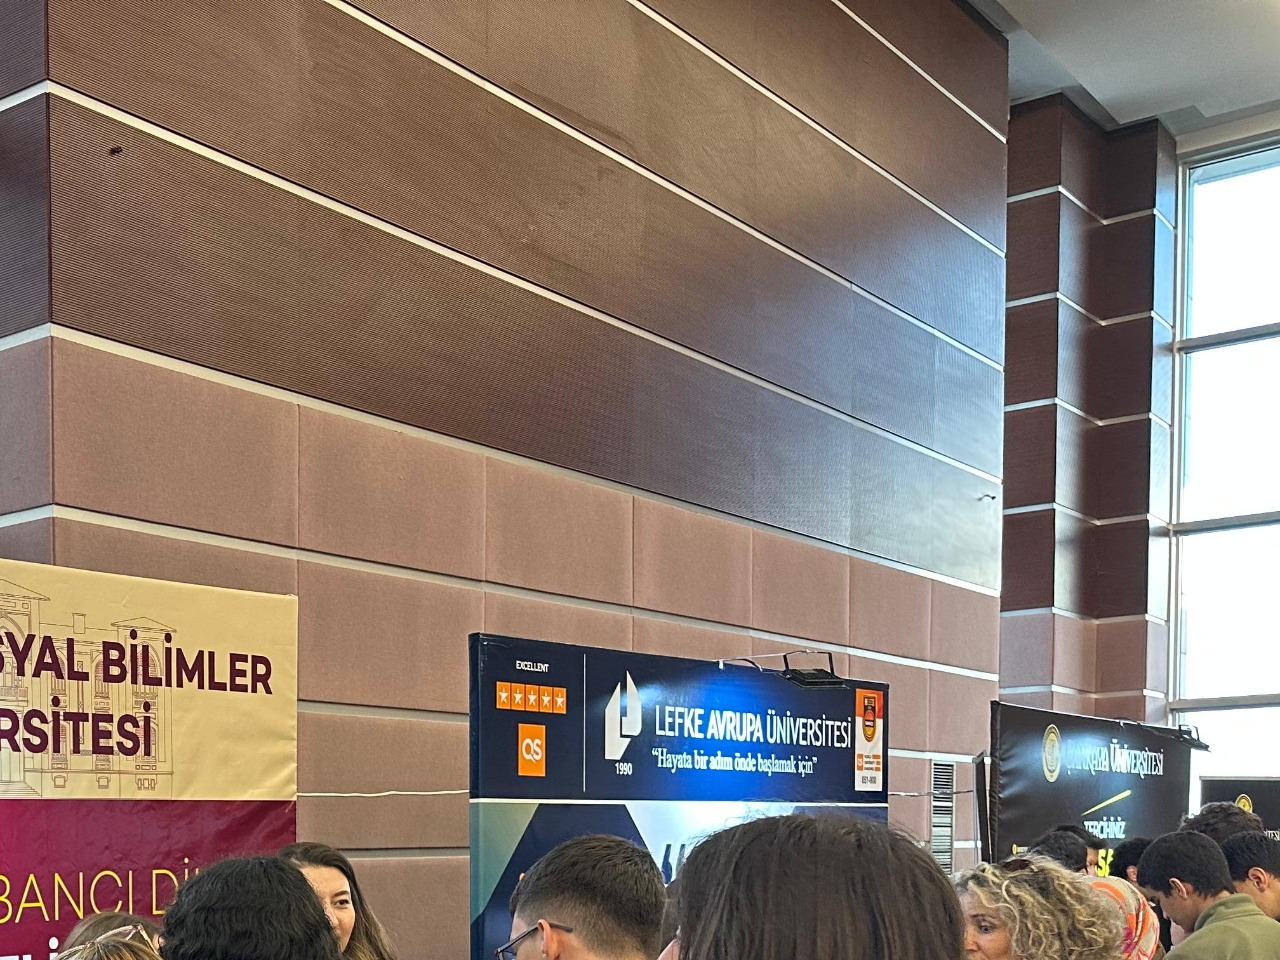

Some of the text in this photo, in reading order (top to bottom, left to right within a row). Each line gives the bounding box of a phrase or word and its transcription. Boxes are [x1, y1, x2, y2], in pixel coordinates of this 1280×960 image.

[102, 628, 273, 696] BİLİMLER
[516, 660, 550, 672] EXCELLENT
[655, 704, 705, 739] LEFKE
[706, 709, 764, 743] AVRUPA
[766, 708, 852, 748] ÜNİVERSİTESİ
[522, 738, 542, 763] QS
[694, 749, 709, 769] bir
[709, 751, 733, 771] adım
[734, 753, 757, 772] önde
[757, 753, 797, 777] başlamak
[1110, 739, 1164, 779] ÜNİVERSİTESİ
[615, 762, 633, 775] 1990
